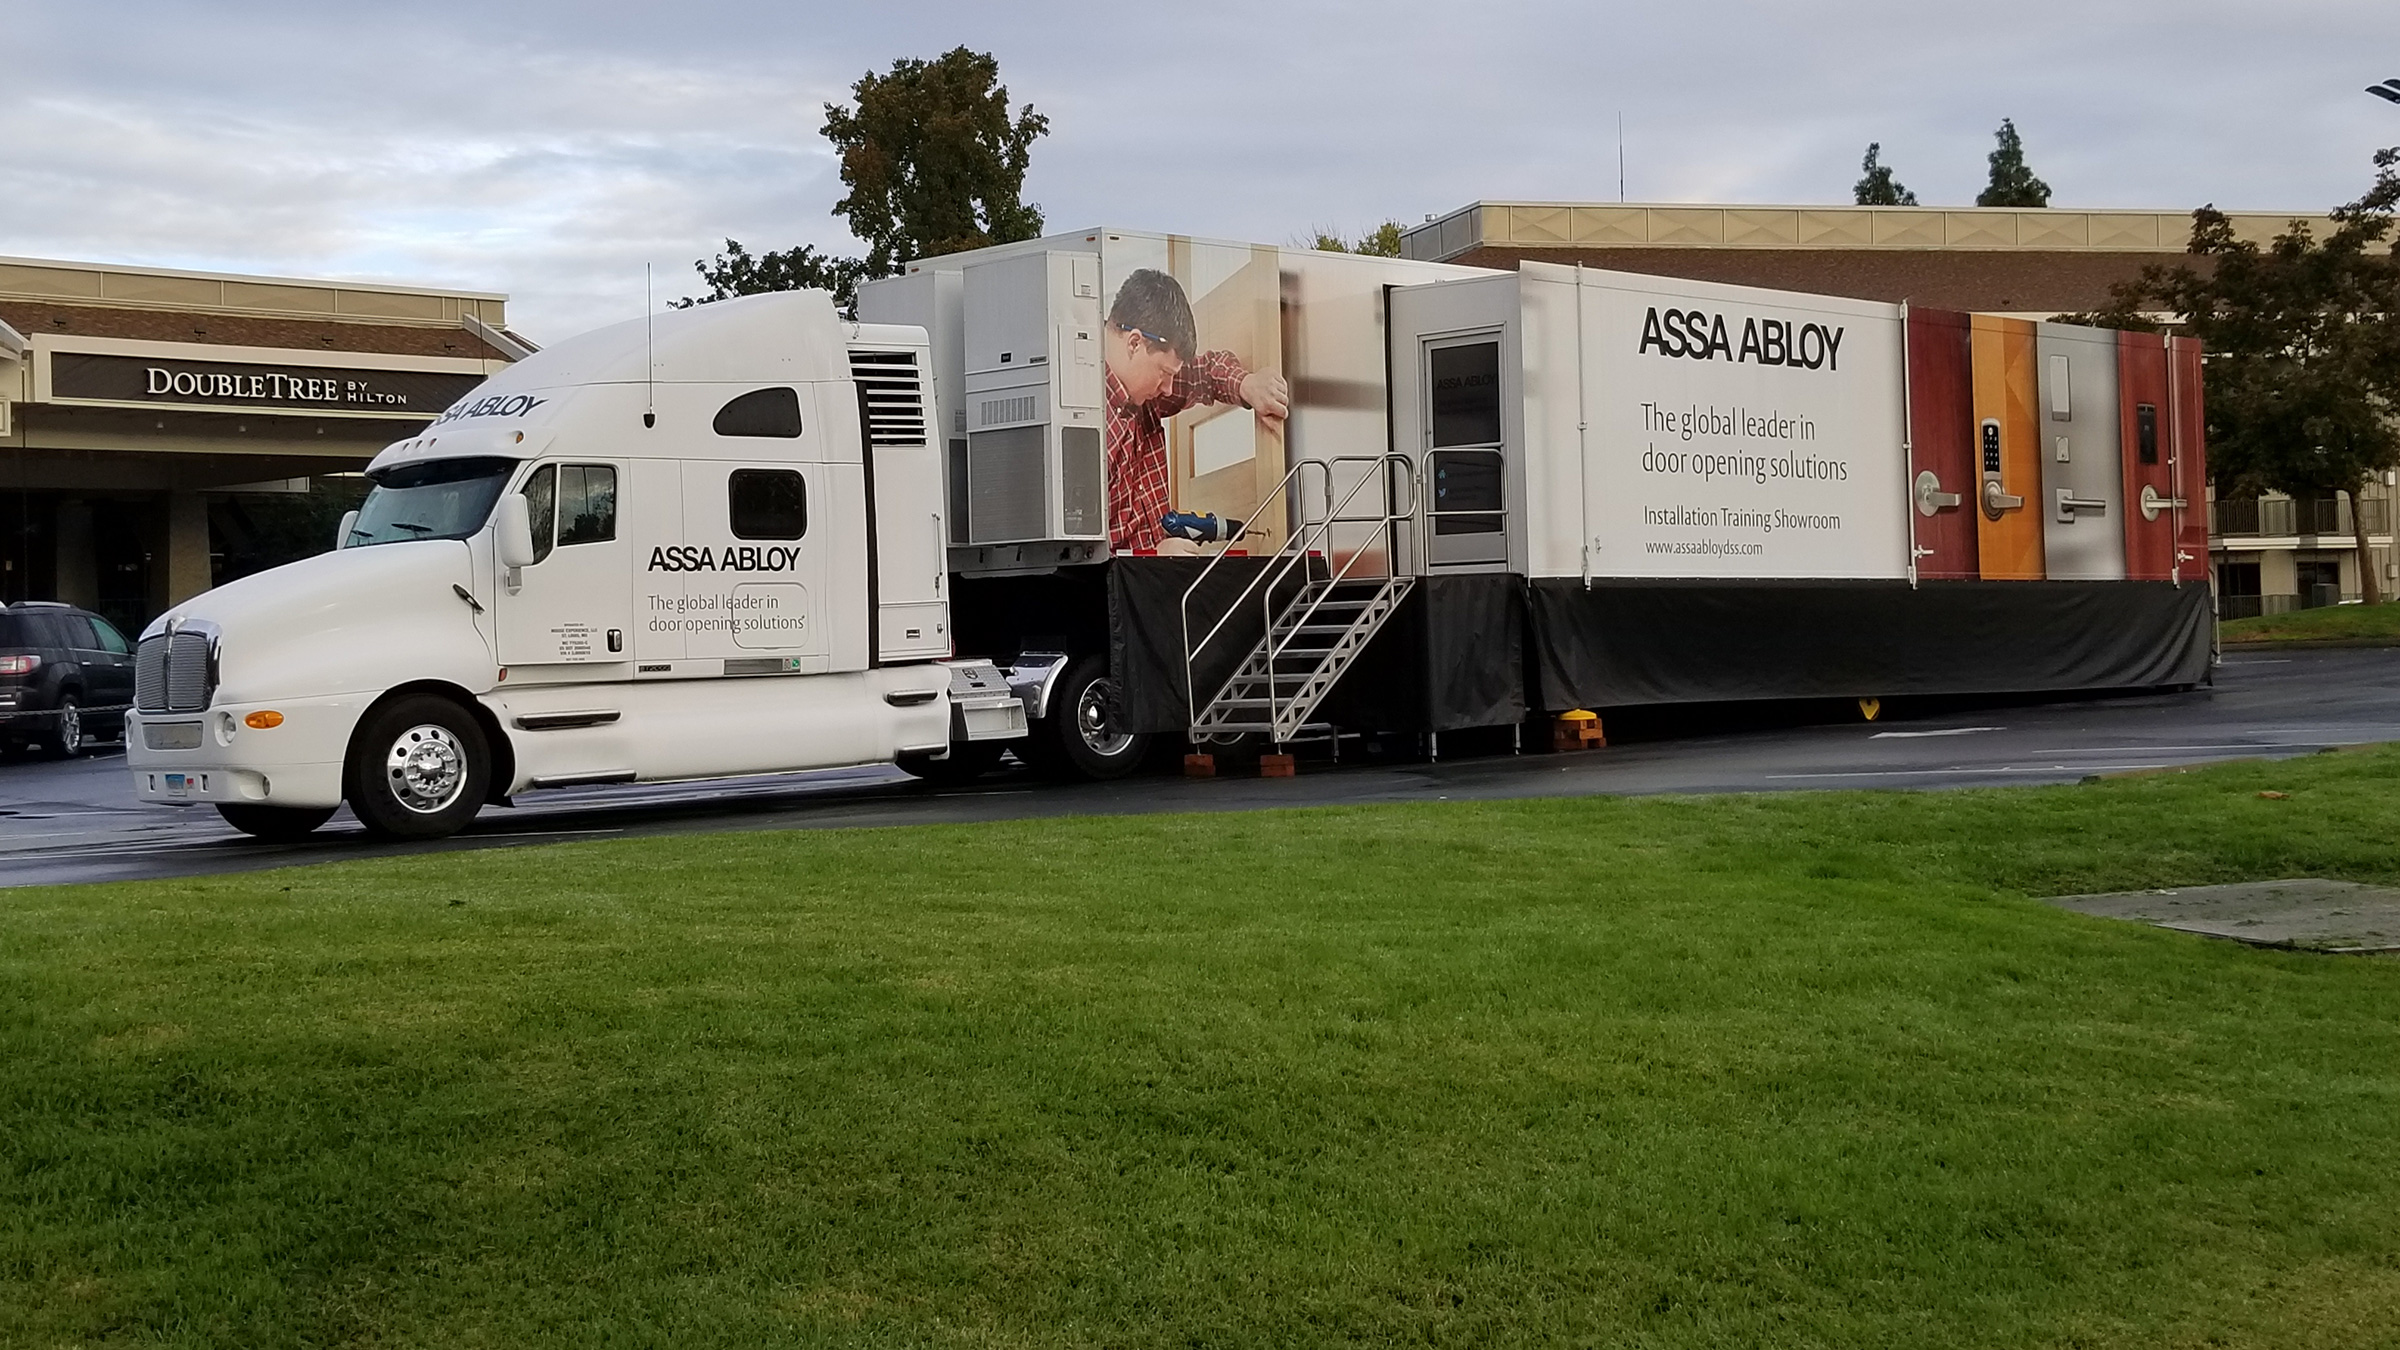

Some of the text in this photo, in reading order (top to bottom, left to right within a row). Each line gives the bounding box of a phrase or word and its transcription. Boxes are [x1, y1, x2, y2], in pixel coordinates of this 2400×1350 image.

[1638, 306, 1845, 372] ASSA ABLOY
[347, 381, 368, 392] BY
[1436, 374, 1497, 390] ASSA ABLOY
[347, 391, 407, 405] HILTON
[460, 395, 550, 420] ABLOY
[1640, 401, 1815, 441] The global leader in
[1642, 442, 1848, 485] door opening solutions
[1644, 504, 1841, 533] Installation Training Showroom
[647, 545, 802, 572] ASSA ABLOY
[1645, 538, 1763, 559] www.assaabloydss.com
[648, 593, 779, 615] The global leader in
[649, 615, 683, 632] door
[685, 615, 742, 635] opening
